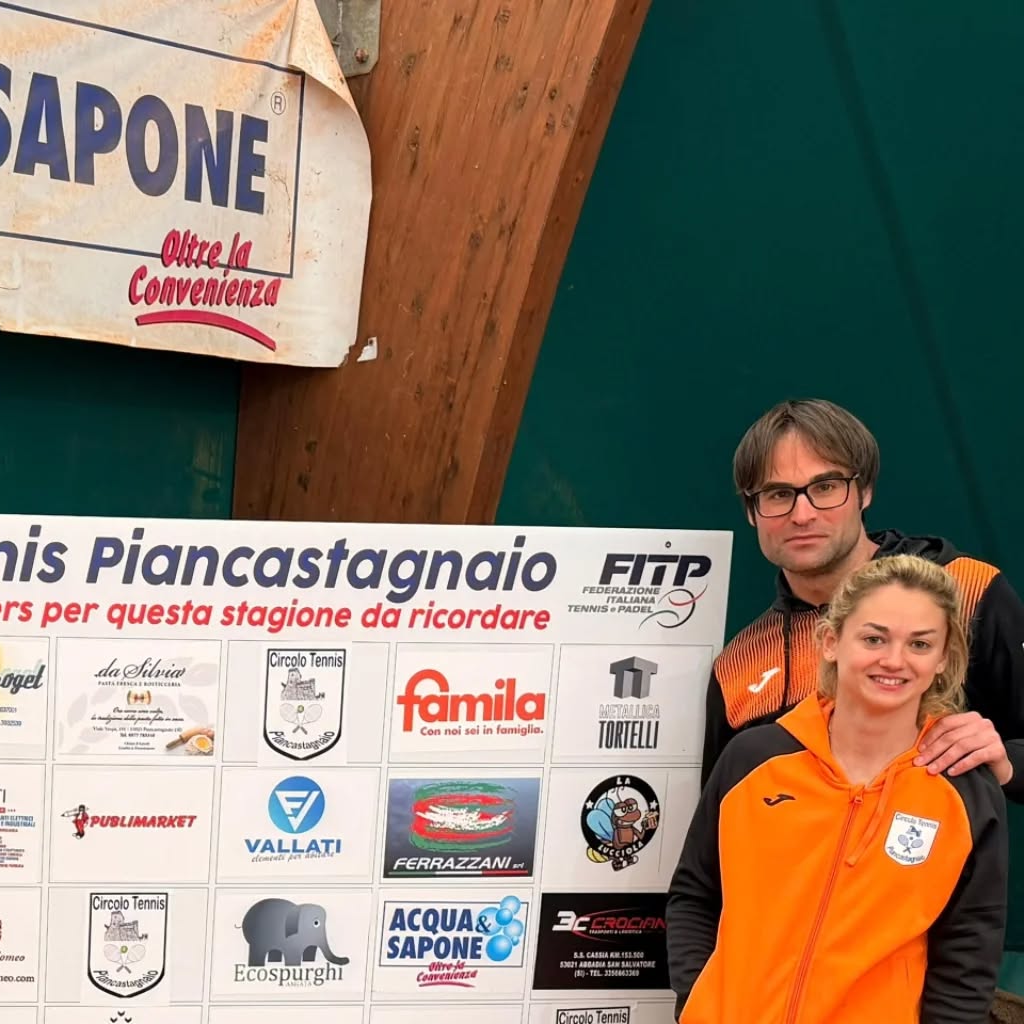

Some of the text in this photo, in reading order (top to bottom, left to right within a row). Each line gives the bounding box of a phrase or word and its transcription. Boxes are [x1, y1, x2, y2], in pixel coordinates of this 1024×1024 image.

[161, 229, 252, 269] Oltre la
[129, 265, 282, 308] Convenienza
[85, 527, 558, 604] Piancastagnaio
[598, 553, 712, 586] FITP
[582, 586, 661, 595] FEDERAZIONE
[606, 596, 656, 604] ITALIANA
[41, 599, 99, 628] per
[107, 599, 213, 629] questa
[220, 598, 352, 634] stagione
[360, 600, 399, 629] da
[408, 600, 551, 630] ricordare
[567, 605, 609, 613] TENNIS
[617, 605, 654, 613] PADEL
[270, 652, 343, 667] Circolo Tennis
[123, 657, 186, 680] Silvia
[397, 669, 546, 732] famila
[598, 704, 660, 719] METALLICA
[420, 725, 544, 737] Con noi sei in famiglia.
[598, 720, 659, 749] TORTELLI
[269, 731, 335, 750] Piancastagnaio
[616, 777, 631, 785] LA
[89, 815, 197, 828] PUBLIMARKET
[244, 839, 341, 854] VALLATI
[598, 841, 644, 857] LUCCIOLA
[393, 856, 512, 871] FERRAZZANI
[93, 896, 165, 910] Circolo Tennis
[389, 908, 473, 935] ACQUA
[387, 936, 483, 960] SAPONE
[93, 970, 158, 988] Piancastagnaio
[234, 962, 343, 986] Ecospurghi
[417, 969, 478, 982] Convenienza
[559, 1010, 627, 1024] Circolo Tennis
